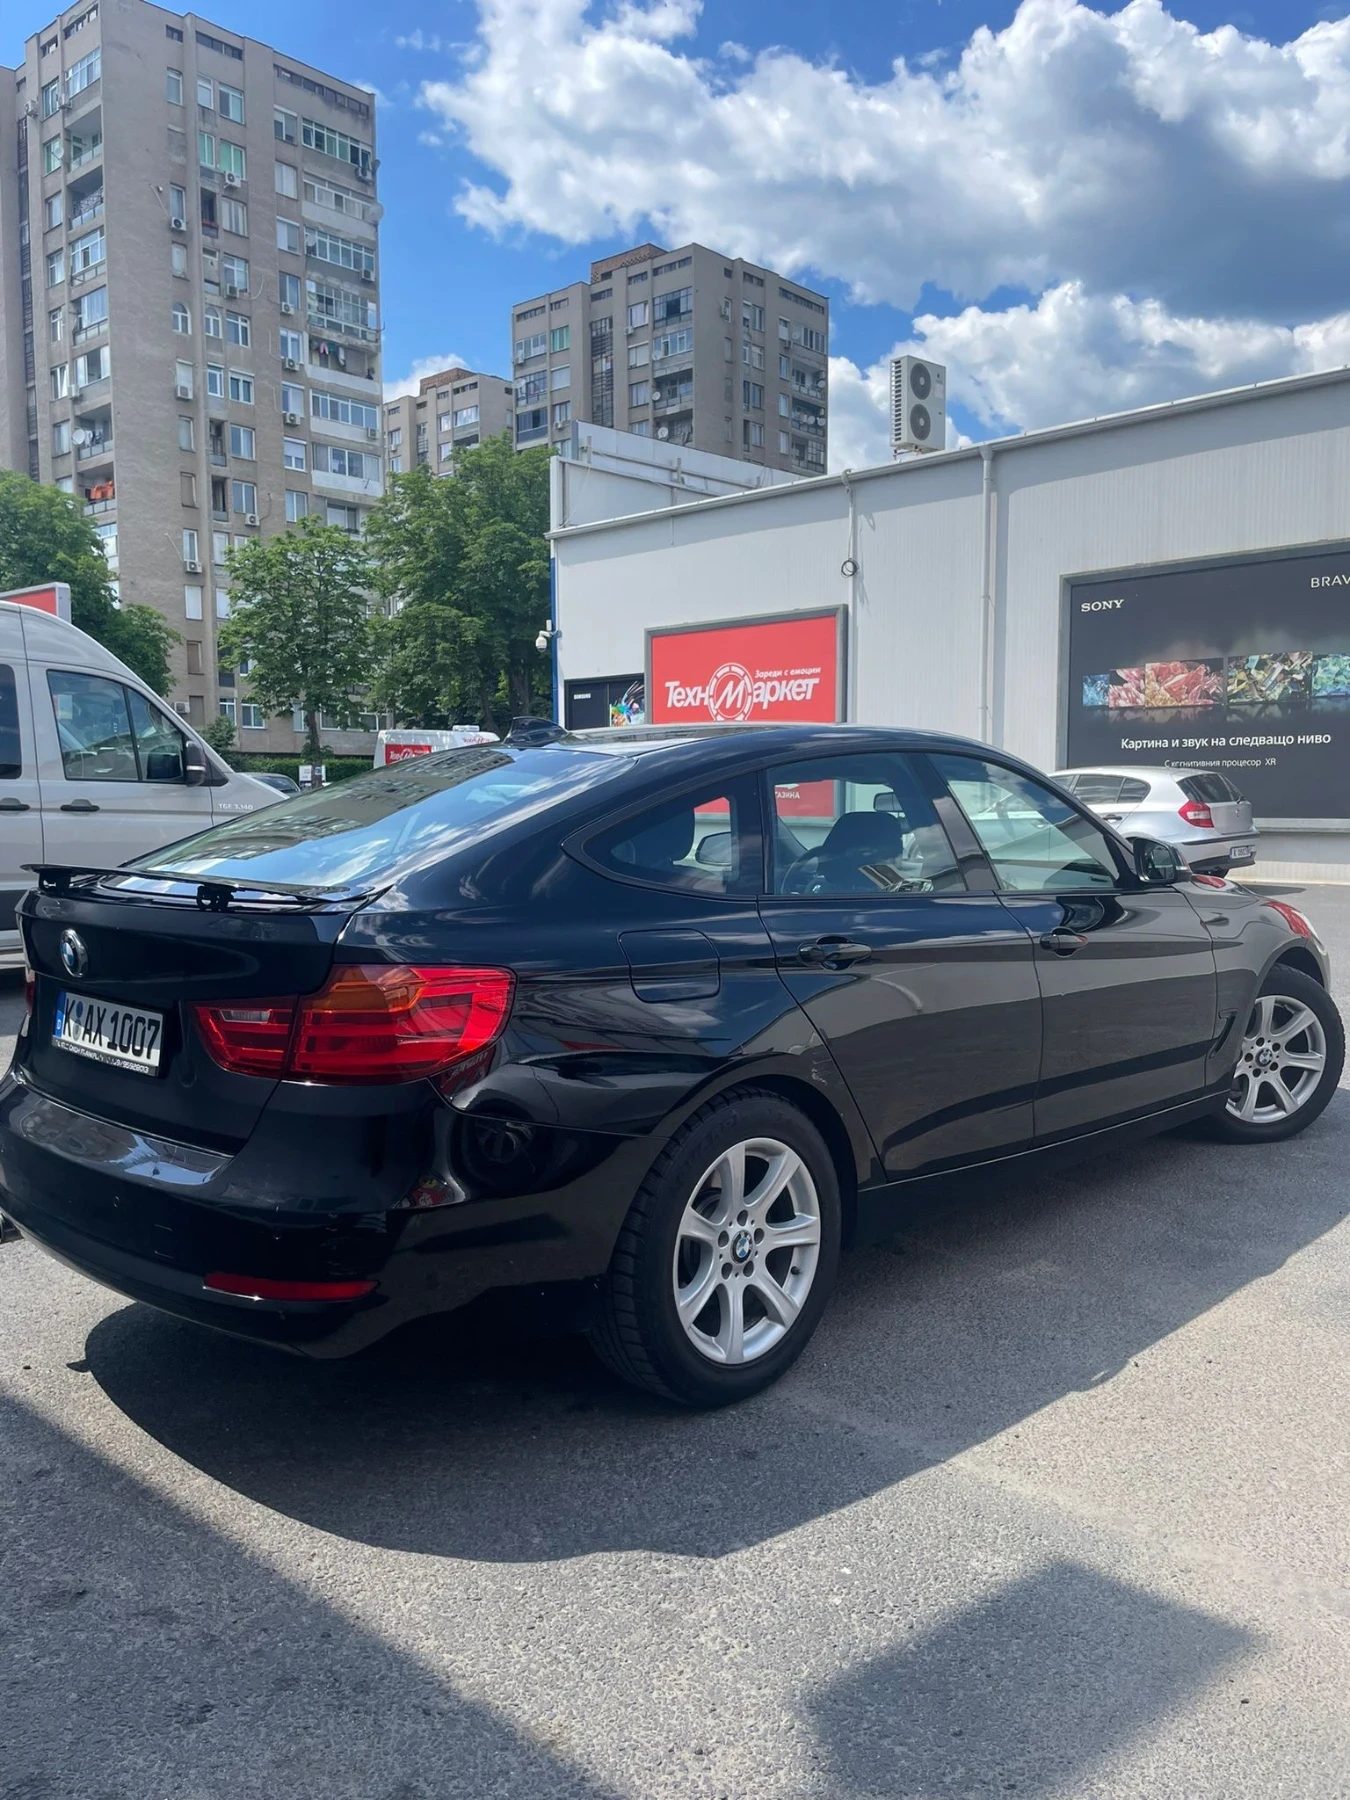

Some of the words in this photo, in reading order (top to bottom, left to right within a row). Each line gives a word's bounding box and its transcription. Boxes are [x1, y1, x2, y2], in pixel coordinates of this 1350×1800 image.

[1081, 599, 1124, 612] SONY
[755, 669, 783, 680] Зареди
[1121, 738, 1169, 750] Картина
[1171, 738, 1179, 748] и
[1182, 737, 1208, 749] звук
[1211, 737, 1226, 746] на
[1228, 735, 1294, 747] следващо
[1297, 734, 1331, 744] ниво
[1222, 759, 1261, 767] процесор
[1265, 757, 1277, 766] XR
[774, 791, 800, 799] АЗИНА
[63, 999, 75, 1037] K
[82, 1004, 107, 1047] AX
[107, 1011, 160, 1060] 1007
